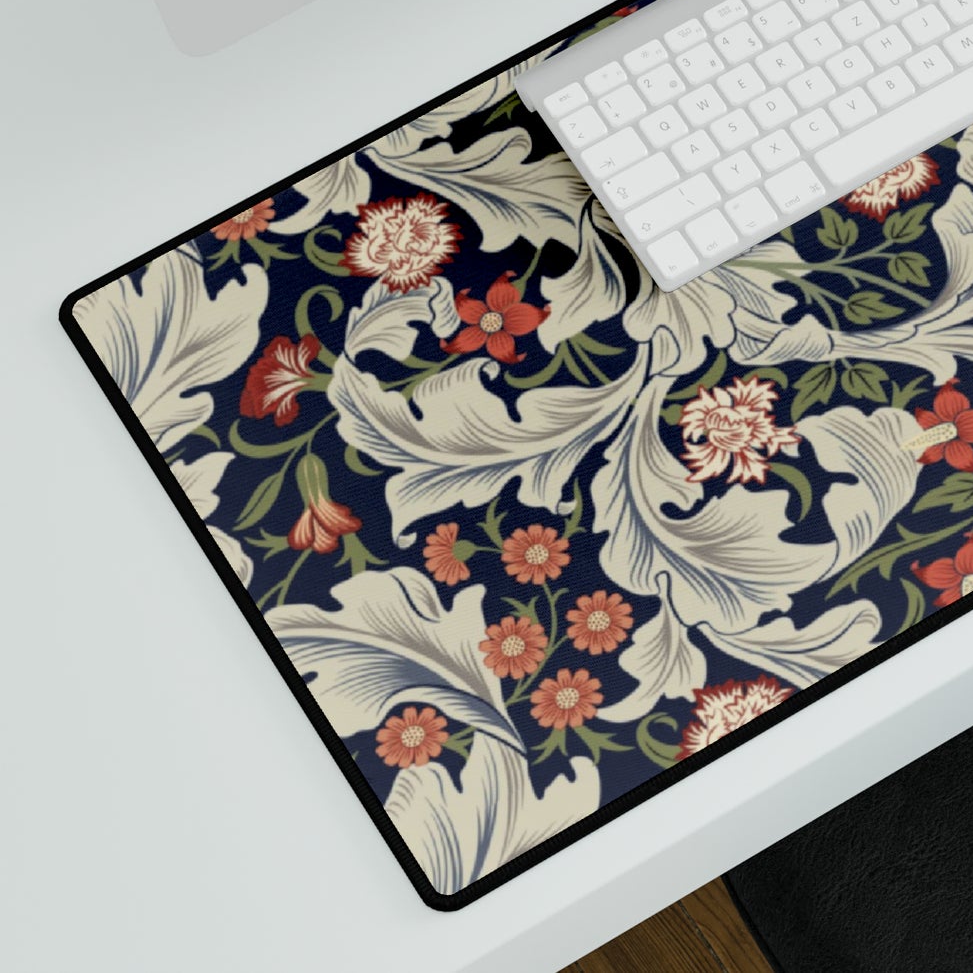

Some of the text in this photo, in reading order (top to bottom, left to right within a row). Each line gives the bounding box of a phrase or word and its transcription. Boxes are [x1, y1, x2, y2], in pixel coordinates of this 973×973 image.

[759, 15, 768, 26] 5
[851, 15, 863, 27] Z
[721, 36, 731, 46] 4
[813, 36, 822, 46] T
[880, 37, 893, 49] H
[960, 37, 973, 49] M
[682, 57, 691, 68] 3
[775, 58, 786, 68] R
[842, 58, 854, 69] G
[922, 58, 935, 69] N
[643, 78, 653, 89] 2
[737, 78, 747, 89] E
[804, 78, 814, 90] F
[885, 79, 896, 90] B
[695, 98, 710, 111] W
[765, 100, 777, 112] D
[846, 99, 857, 111] V
[659, 121, 671, 132] Q
[727, 122, 738, 132] S
[808, 121, 820, 132] C
[690, 143, 700, 155] A
[768, 142, 782, 154] X
[730, 163, 740, 174] Y
